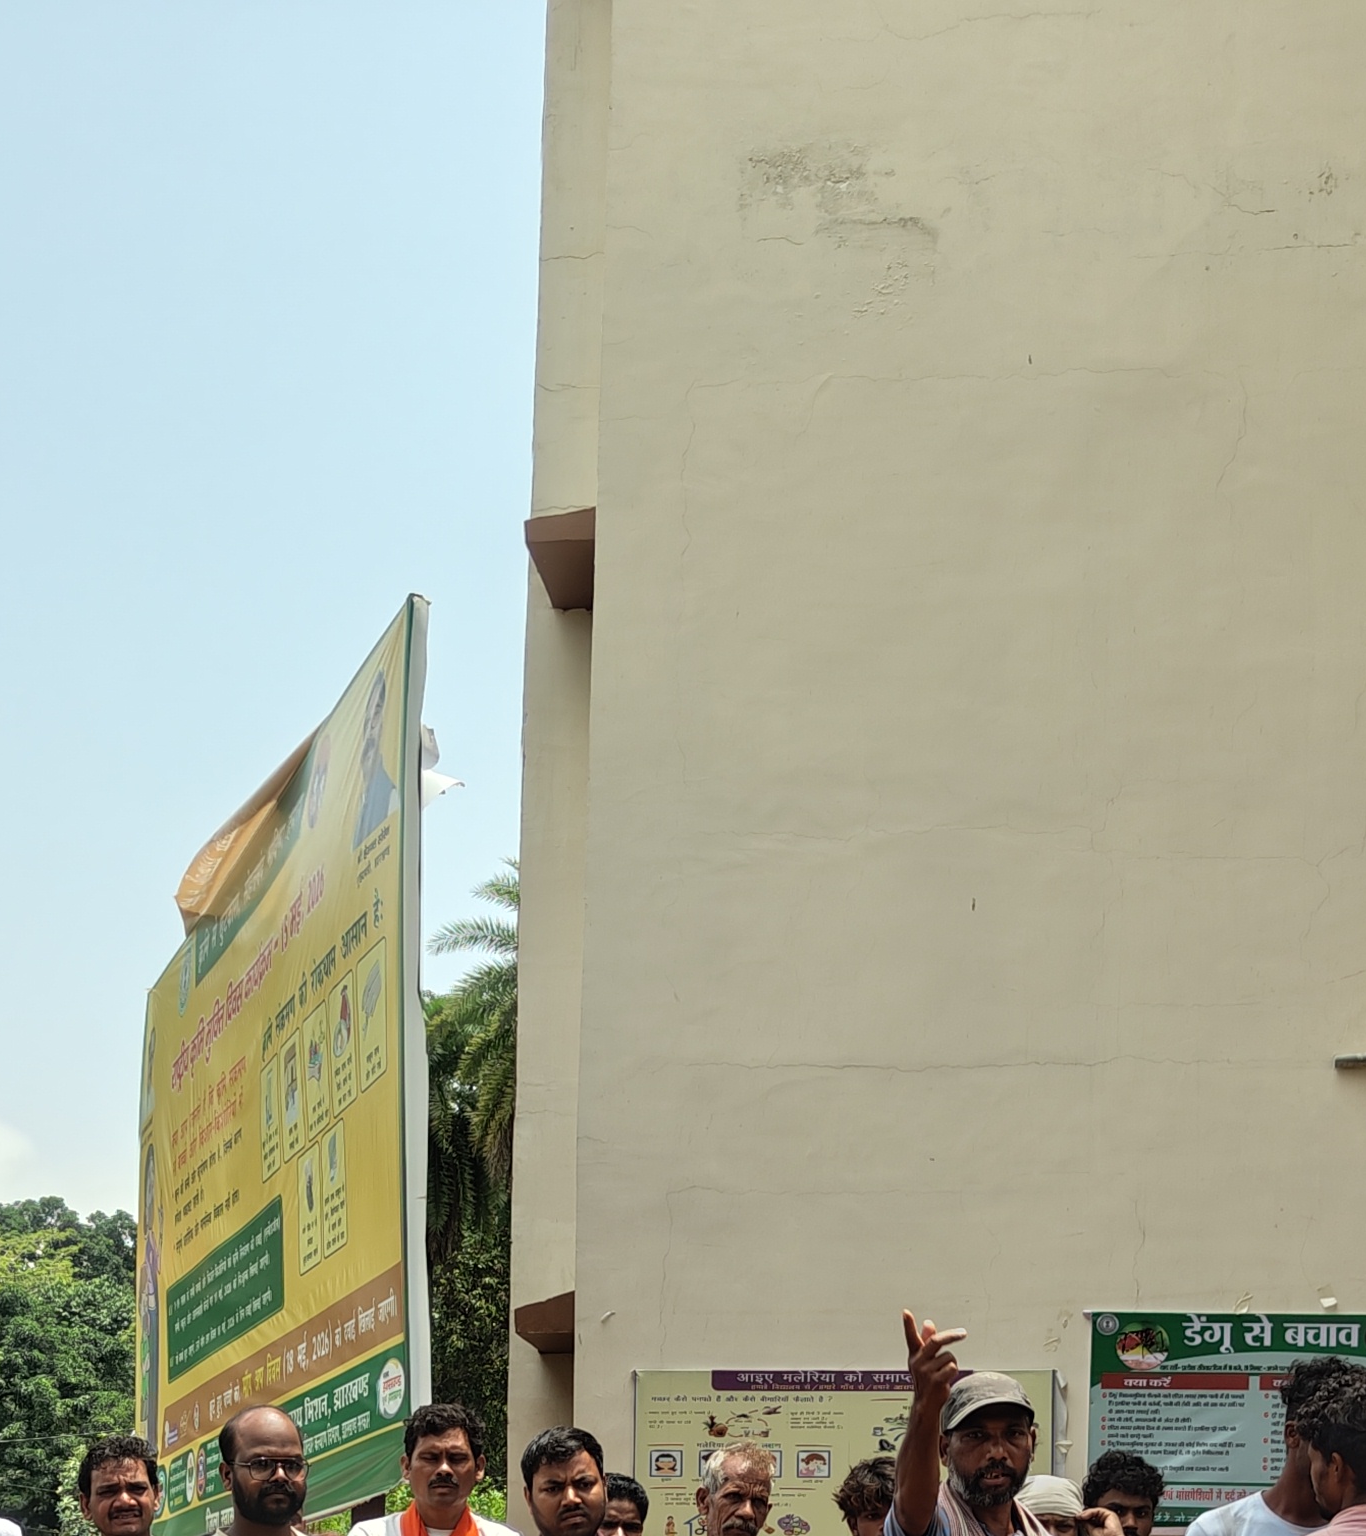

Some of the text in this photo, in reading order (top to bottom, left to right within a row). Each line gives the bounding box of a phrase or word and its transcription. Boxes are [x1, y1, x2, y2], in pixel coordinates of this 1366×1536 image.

[1183, 1313, 1360, 1353] डेंगू से बचाव
[737, 1374, 773, 1383] आइए
[783, 1371, 834, 1383] मलेरिया
[845, 1371, 862, 1383] को
[1124, 1376, 1172, 1387] क्या करें
